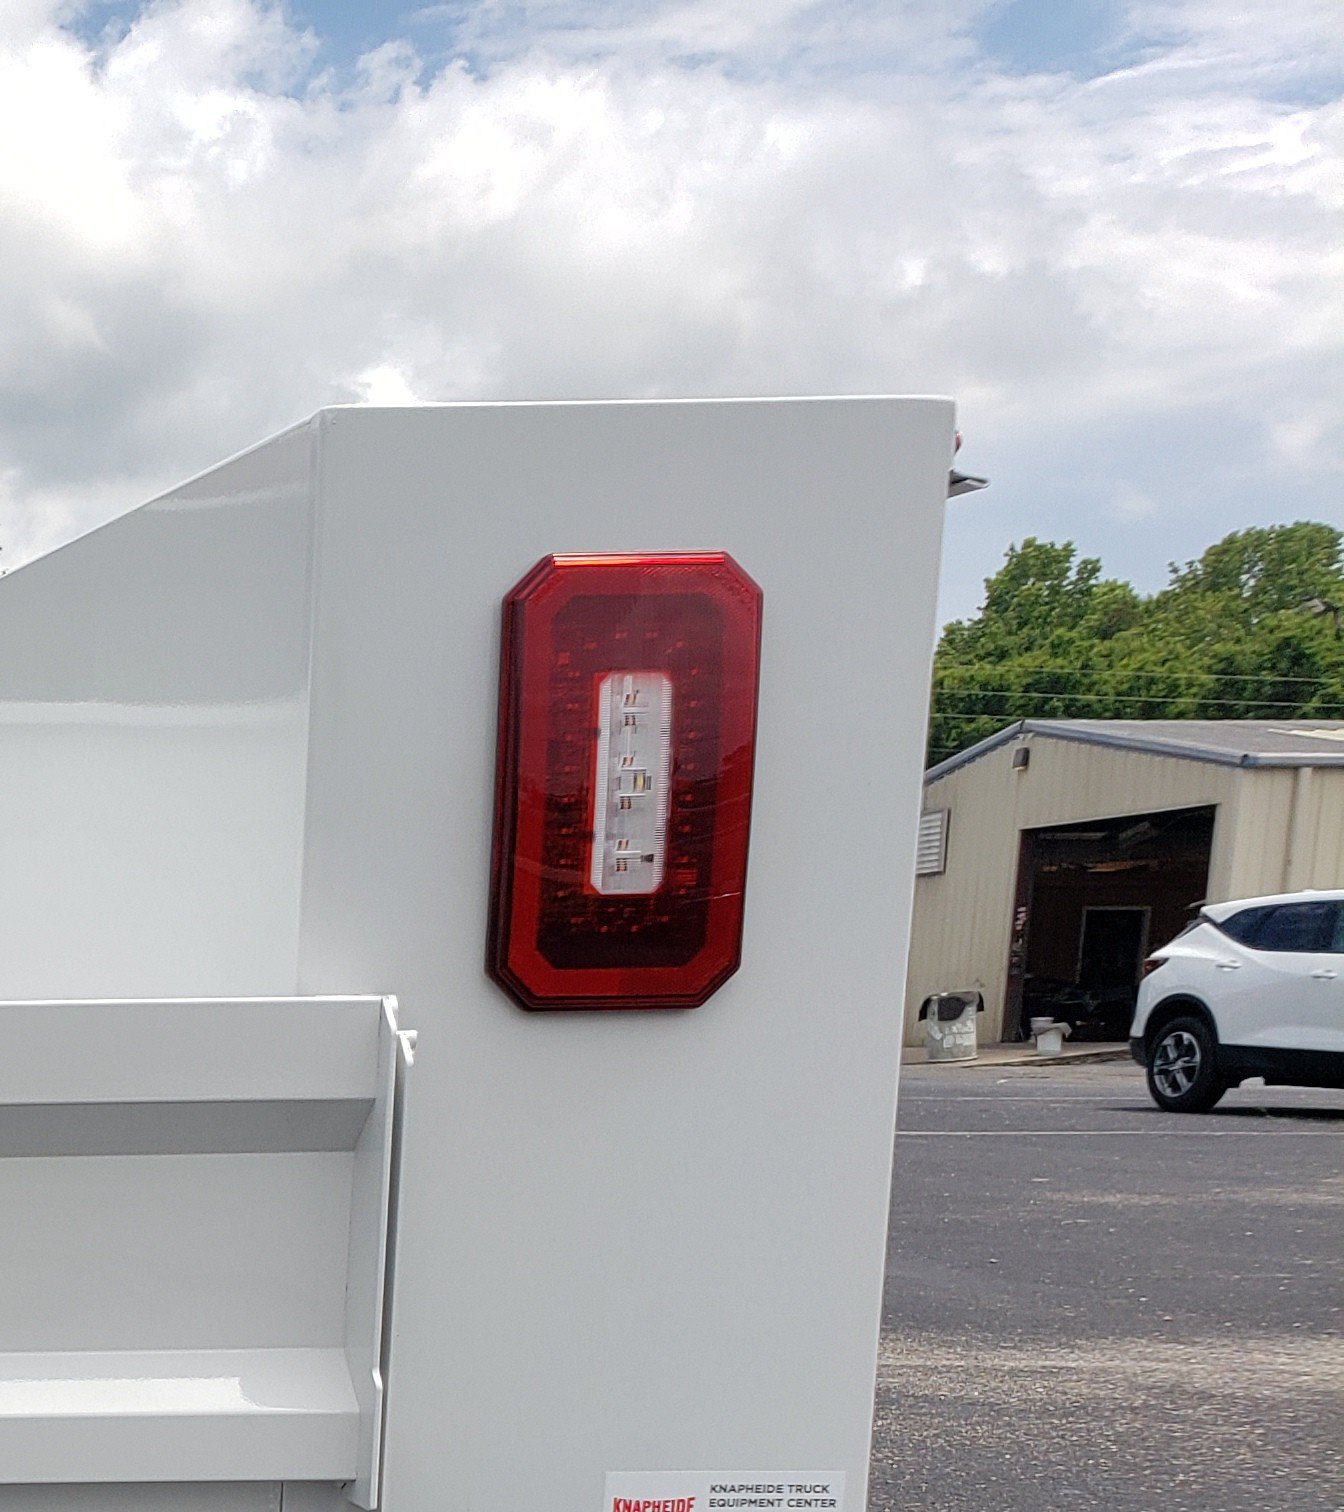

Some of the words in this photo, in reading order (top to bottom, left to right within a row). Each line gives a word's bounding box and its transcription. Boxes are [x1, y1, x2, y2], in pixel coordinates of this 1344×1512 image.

[710, 1484, 785, 1494] KNAPHEIDE
[788, 1484, 830, 1494] TRUCK
[708, 1498, 784, 1508] EQUIPMENT
[787, 1498, 837, 1508] CENTER
